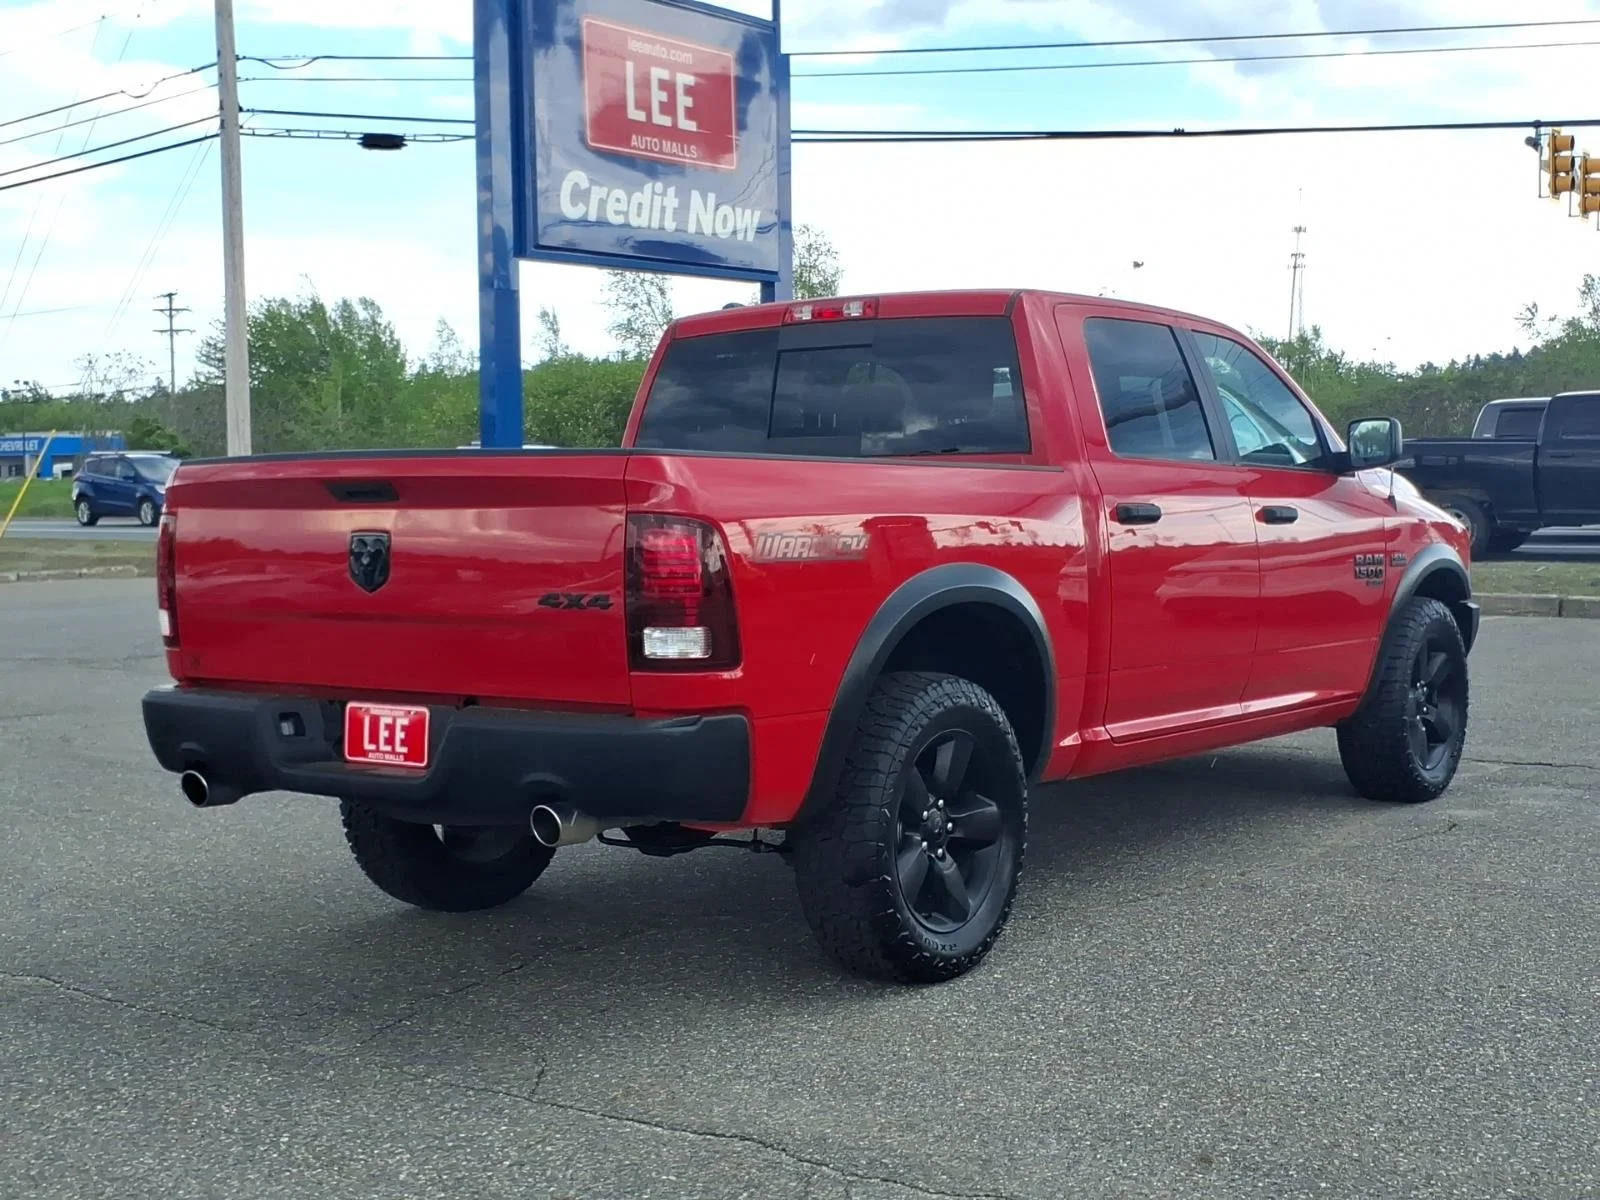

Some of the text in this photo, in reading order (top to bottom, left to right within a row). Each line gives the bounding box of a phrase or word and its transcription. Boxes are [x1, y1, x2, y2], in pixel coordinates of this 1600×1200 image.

[627, 36, 693, 65] leeauto.com
[625, 61, 697, 132] LEE
[630, 134, 698, 159] AUTO MALLS
[560, 169, 761, 242] Credit Now
[1354, 553, 1385, 567] RAM
[1354, 567, 1384, 579] 1500
[363, 715, 410, 754] LEE
[368, 752, 405, 762] AUTO MALLS
